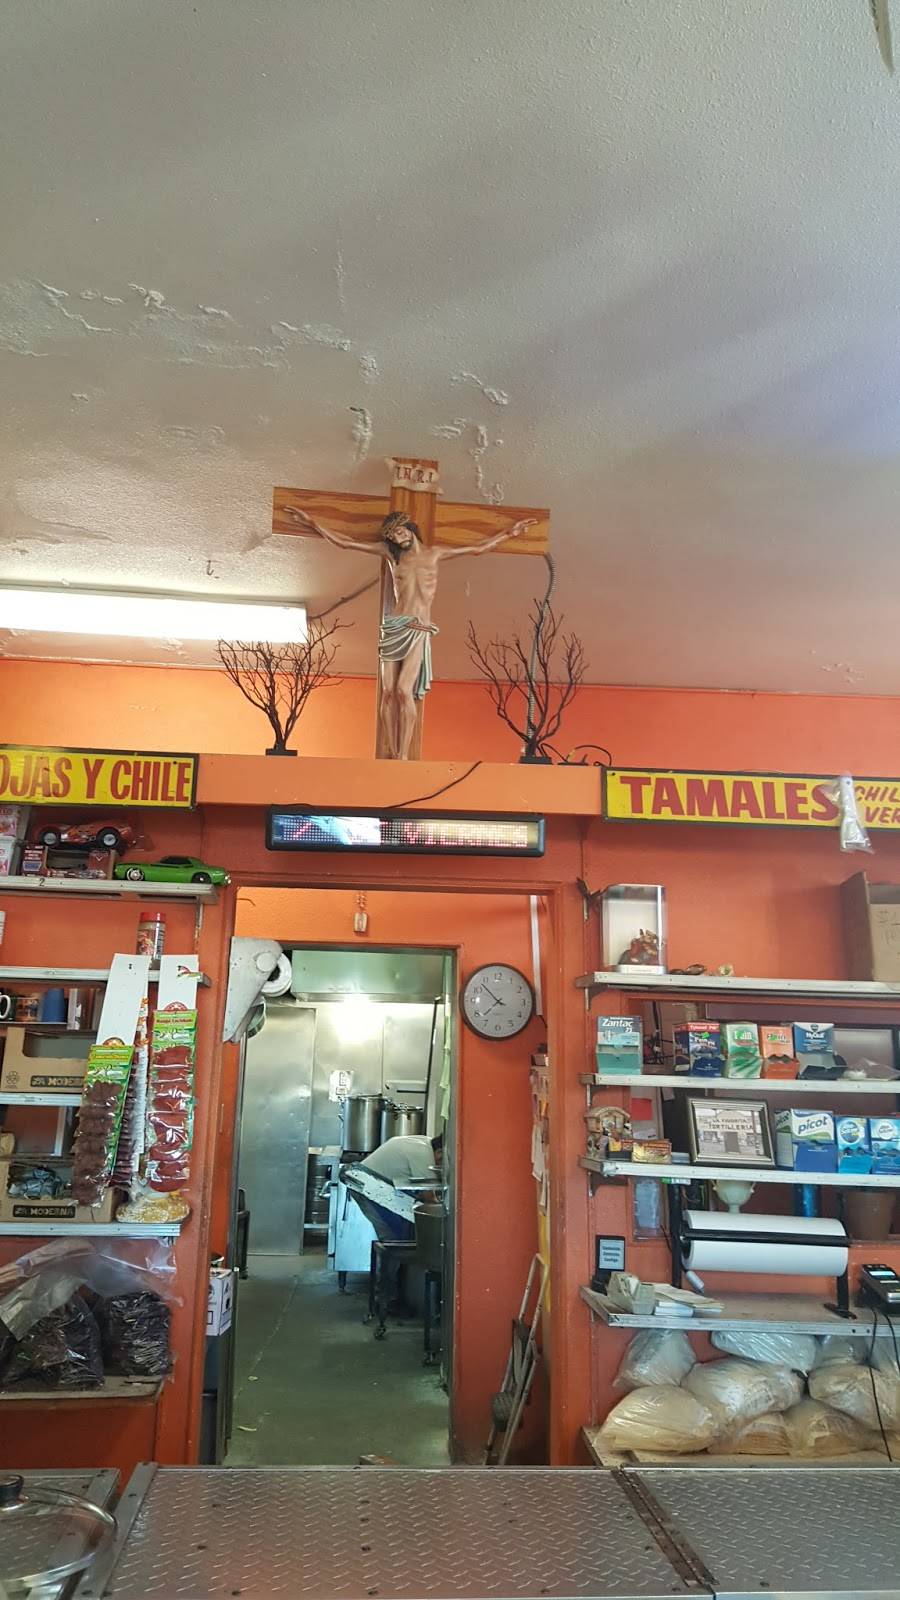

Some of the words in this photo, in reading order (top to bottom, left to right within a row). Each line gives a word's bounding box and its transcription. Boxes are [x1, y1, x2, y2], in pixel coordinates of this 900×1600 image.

[83, 758, 105, 800] Y
[110, 760, 192, 802] CHILE
[620, 775, 840, 821] TAMALES
[602, 1018, 634, 1028] Zantac
[798, 1116, 828, 1135] picot
